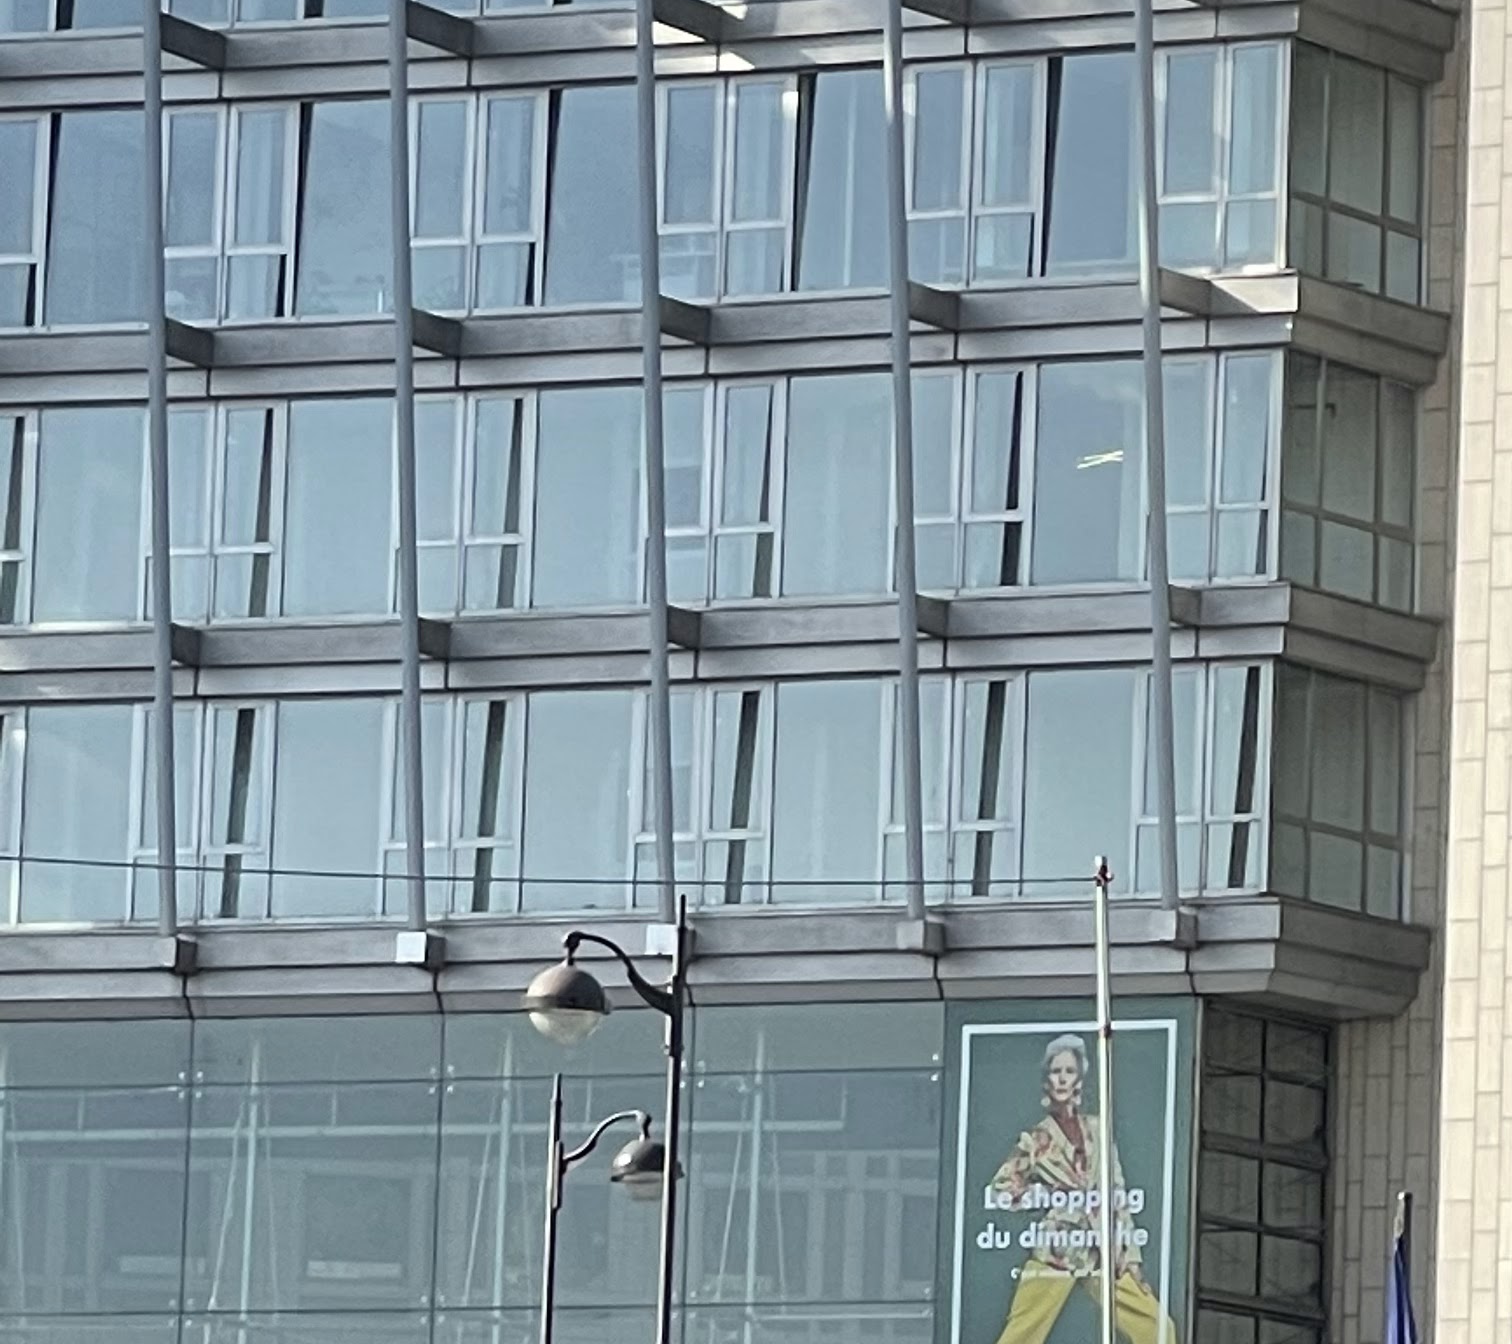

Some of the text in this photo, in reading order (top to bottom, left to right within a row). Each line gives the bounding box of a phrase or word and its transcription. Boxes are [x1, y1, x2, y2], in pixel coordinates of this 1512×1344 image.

[983, 1181, 1146, 1214] Le shoppng
[976, 1220, 1150, 1249] du dimanhe
